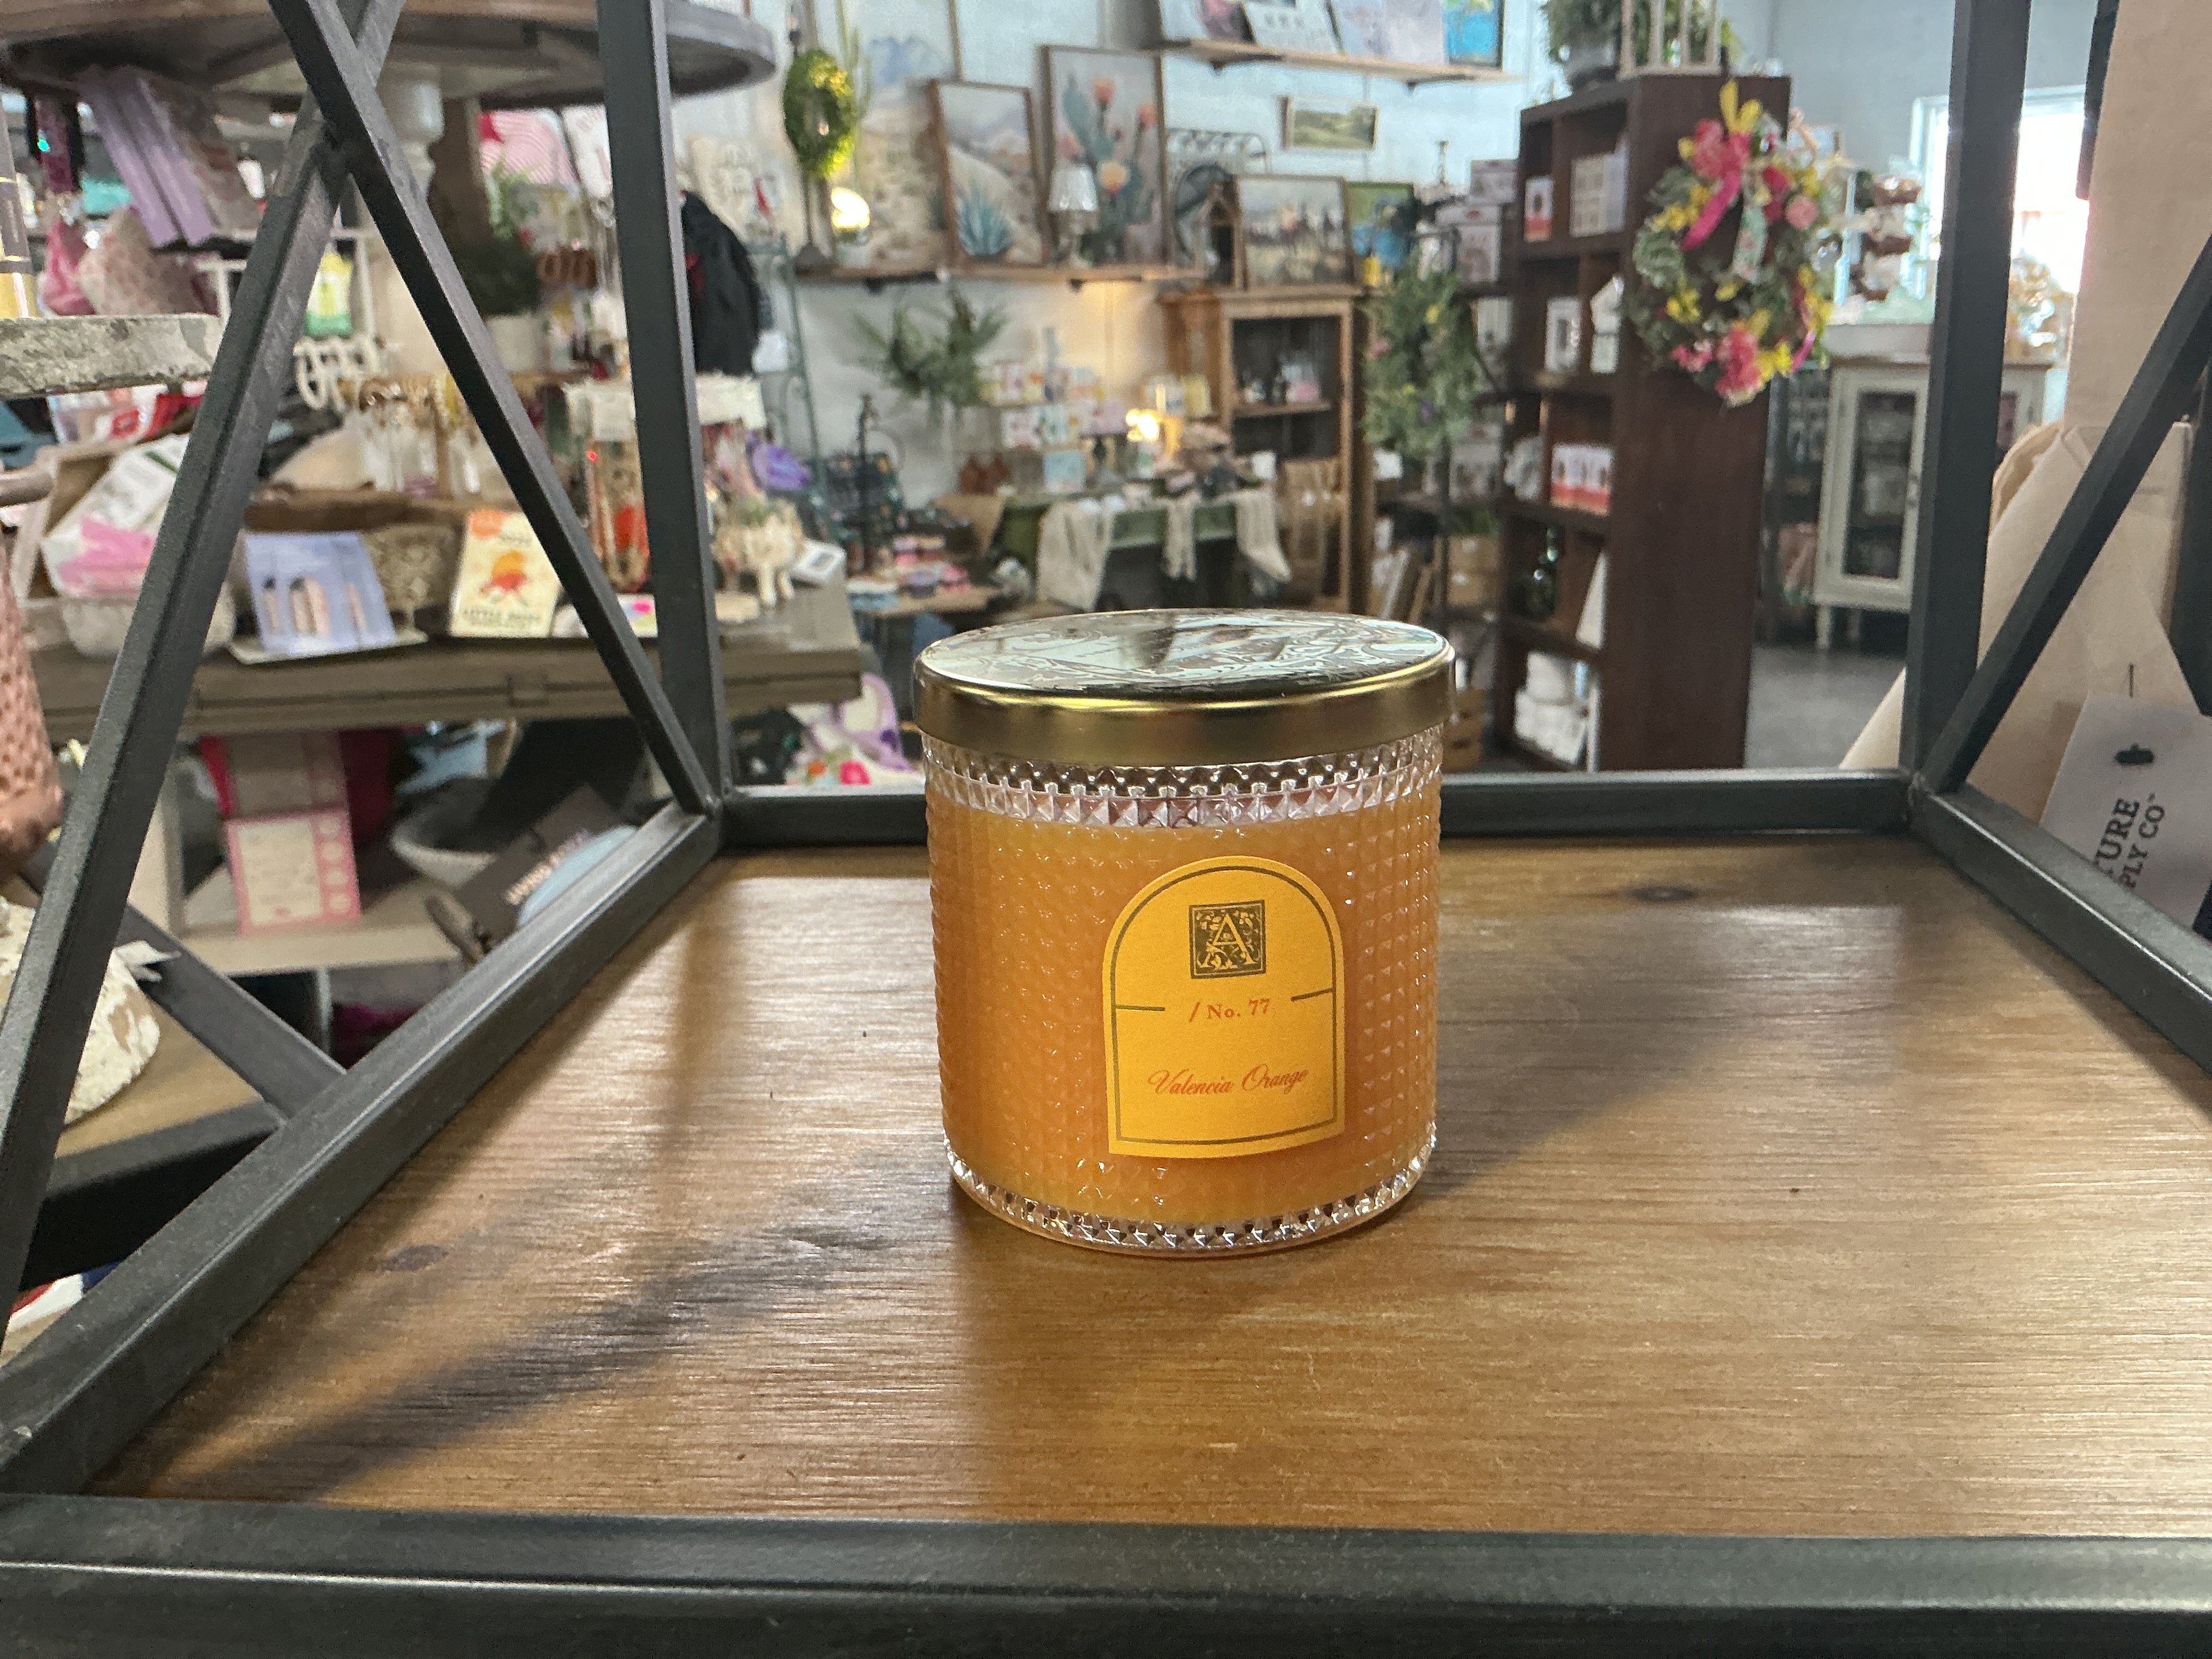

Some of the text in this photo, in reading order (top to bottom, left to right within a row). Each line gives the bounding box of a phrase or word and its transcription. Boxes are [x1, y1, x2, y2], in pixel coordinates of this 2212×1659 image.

[1196, 911, 1258, 969] A
[1206, 1003, 1241, 1020] No.
[1248, 997, 1271, 1016] 77
[1147, 1063, 1309, 1095] Valencia Orange
